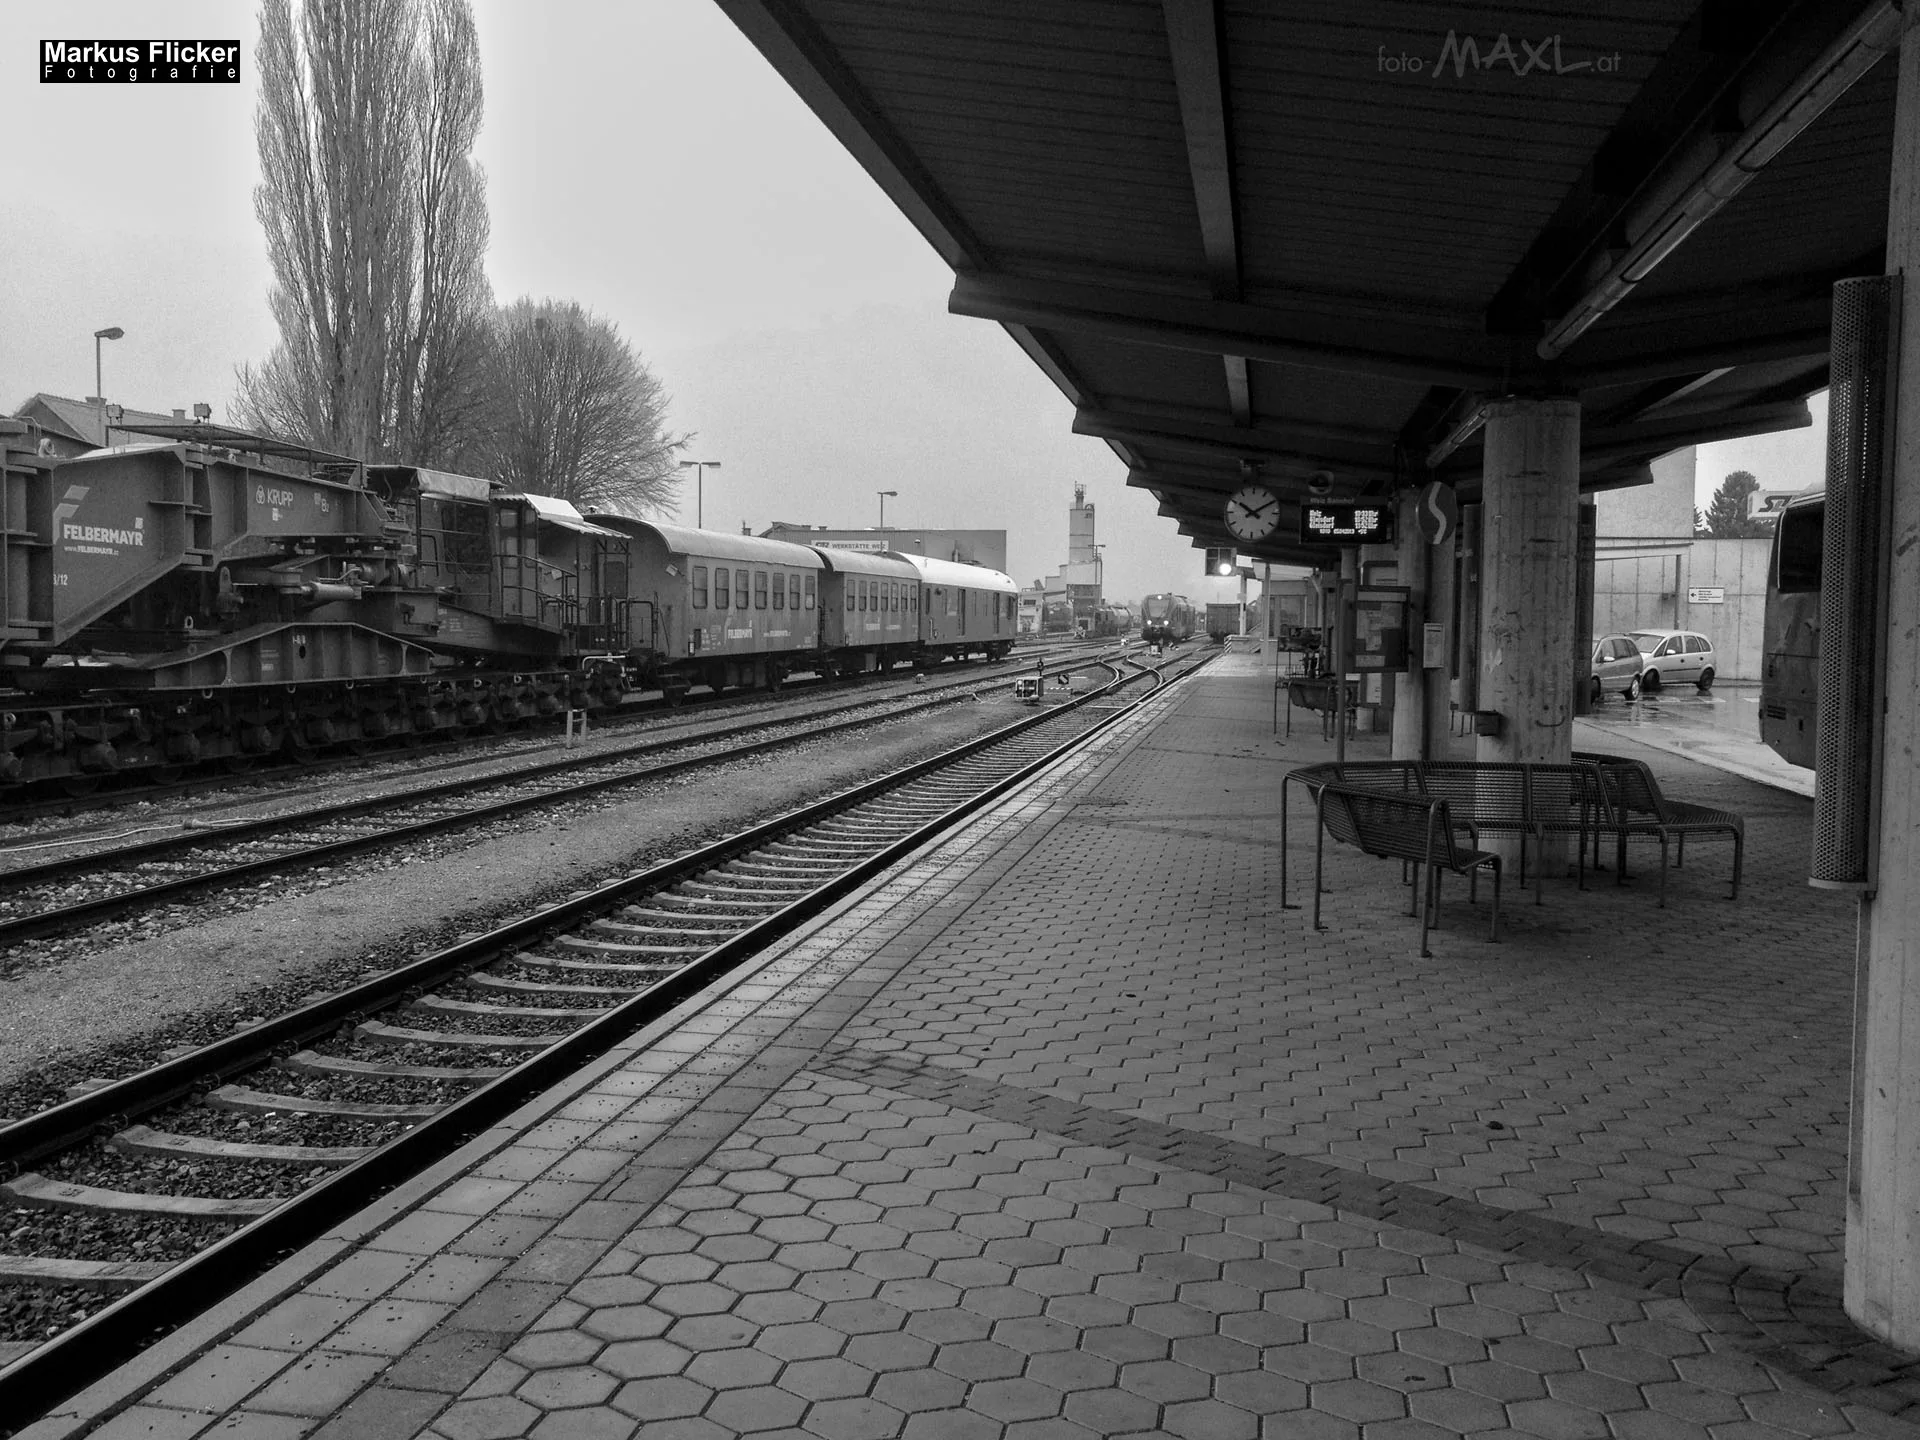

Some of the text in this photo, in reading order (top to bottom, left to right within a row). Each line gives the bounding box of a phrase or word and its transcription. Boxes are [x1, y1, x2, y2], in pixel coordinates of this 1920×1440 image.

[267, 488, 294, 508] KRUPP
[63, 523, 143, 546] FELBERMAYR
[832, 542, 869, 550] WERKSTÄTTE
